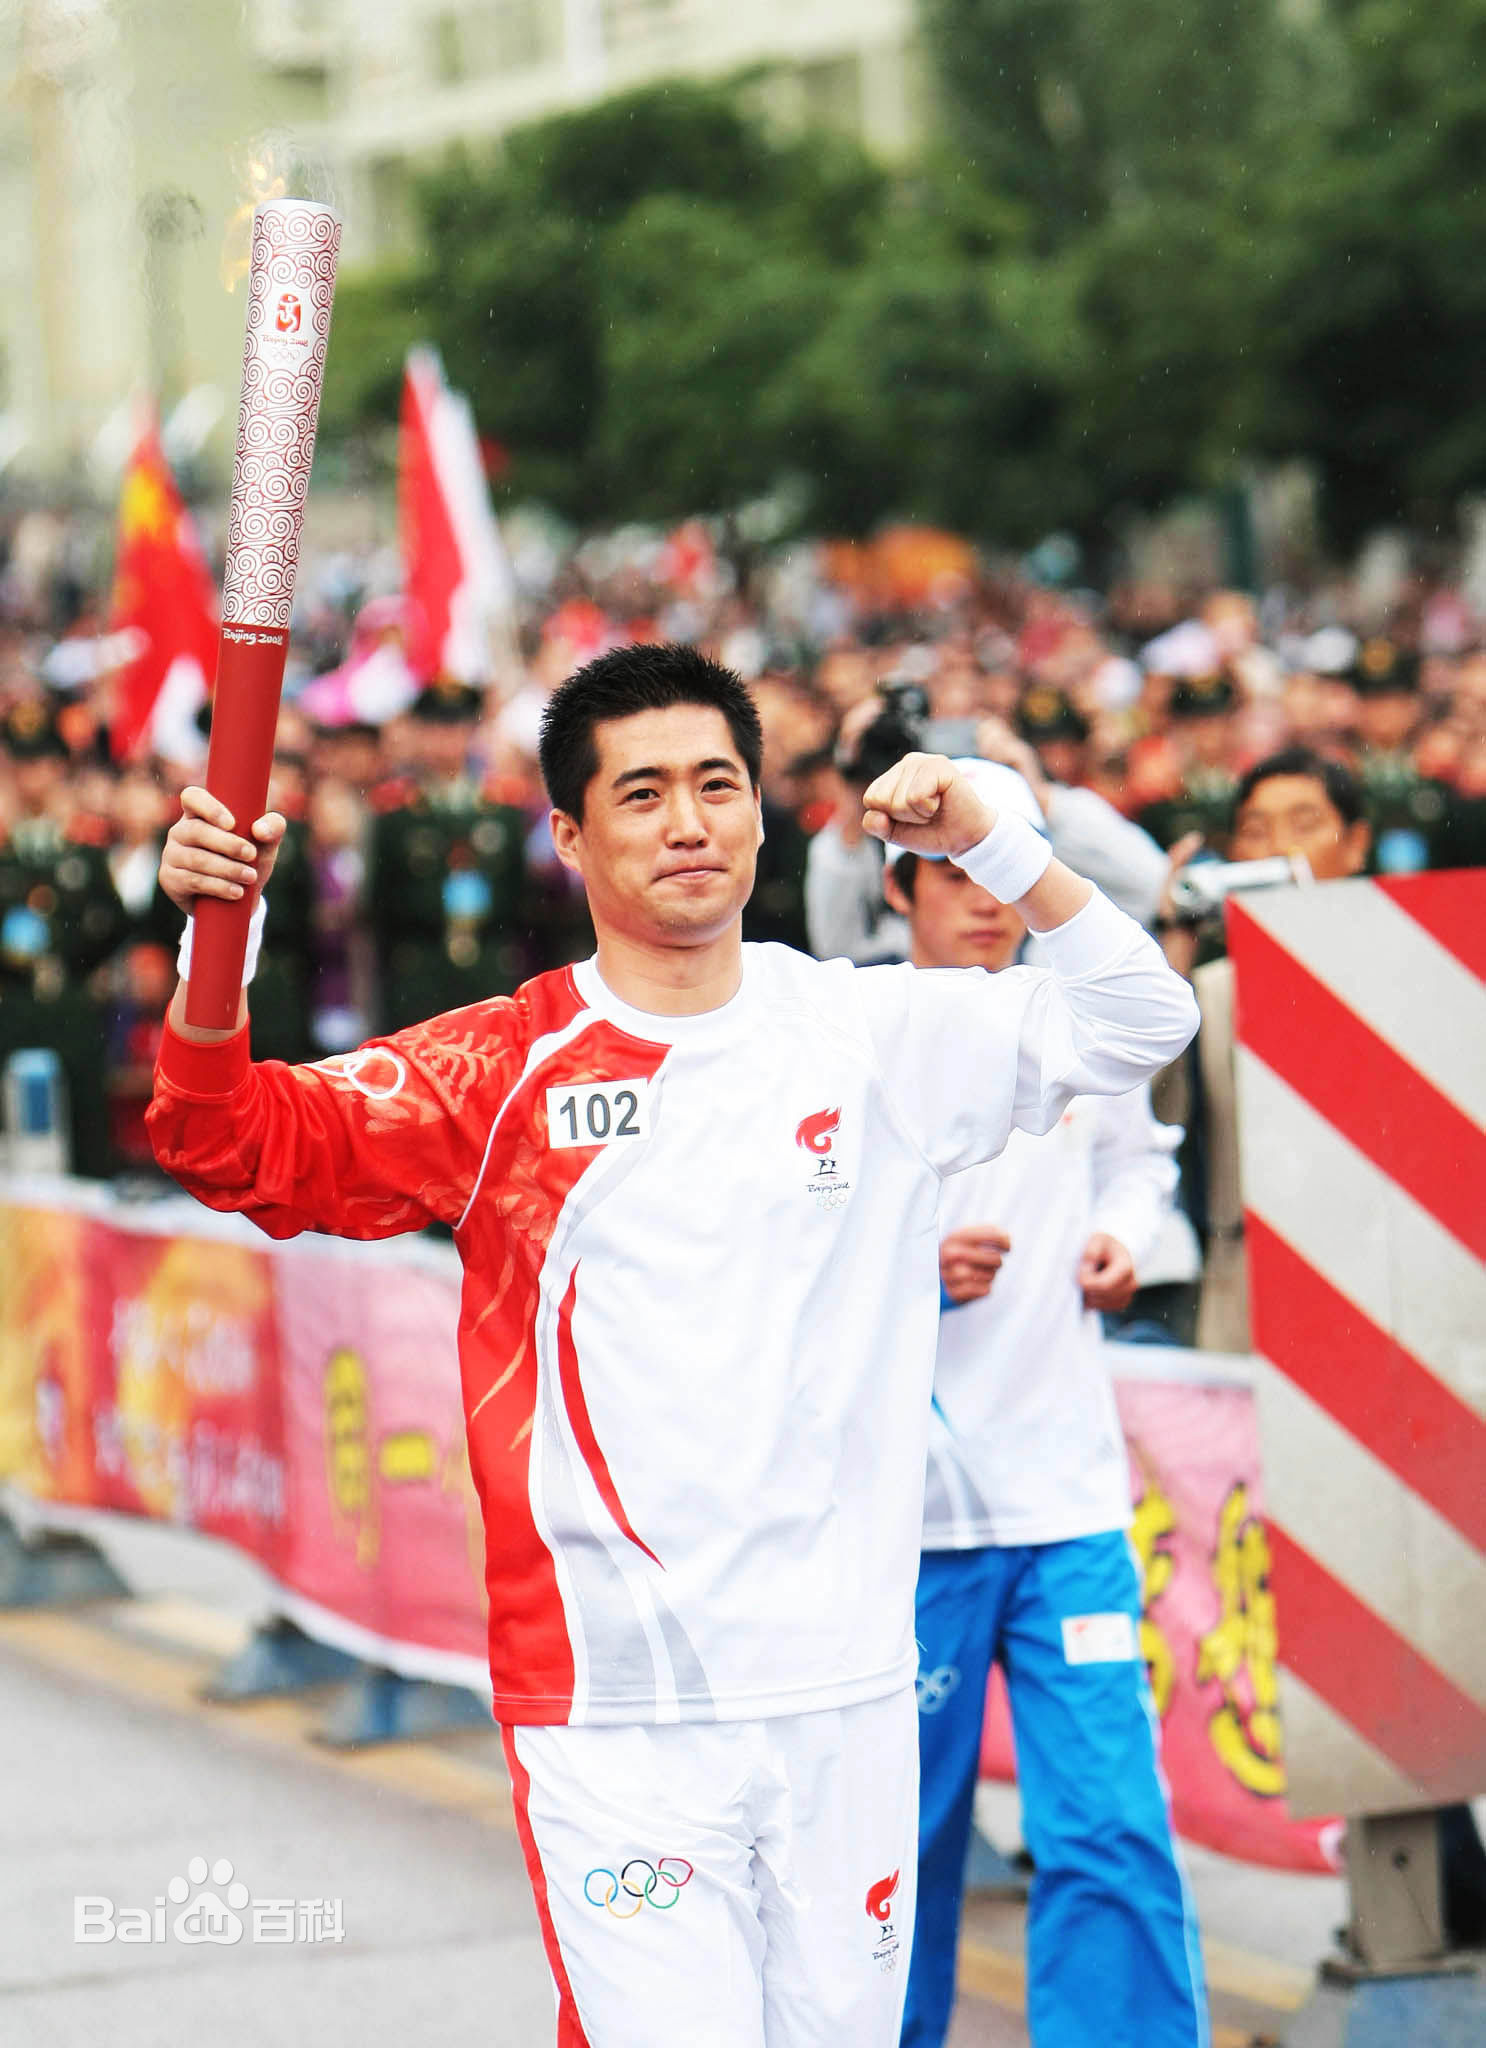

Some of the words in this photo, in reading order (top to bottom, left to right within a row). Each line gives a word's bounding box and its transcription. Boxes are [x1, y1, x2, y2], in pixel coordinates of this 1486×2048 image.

[222, 627, 257, 645] Beijing
[257, 633, 283, 646] 2008
[560, 1091, 640, 1140] 102
